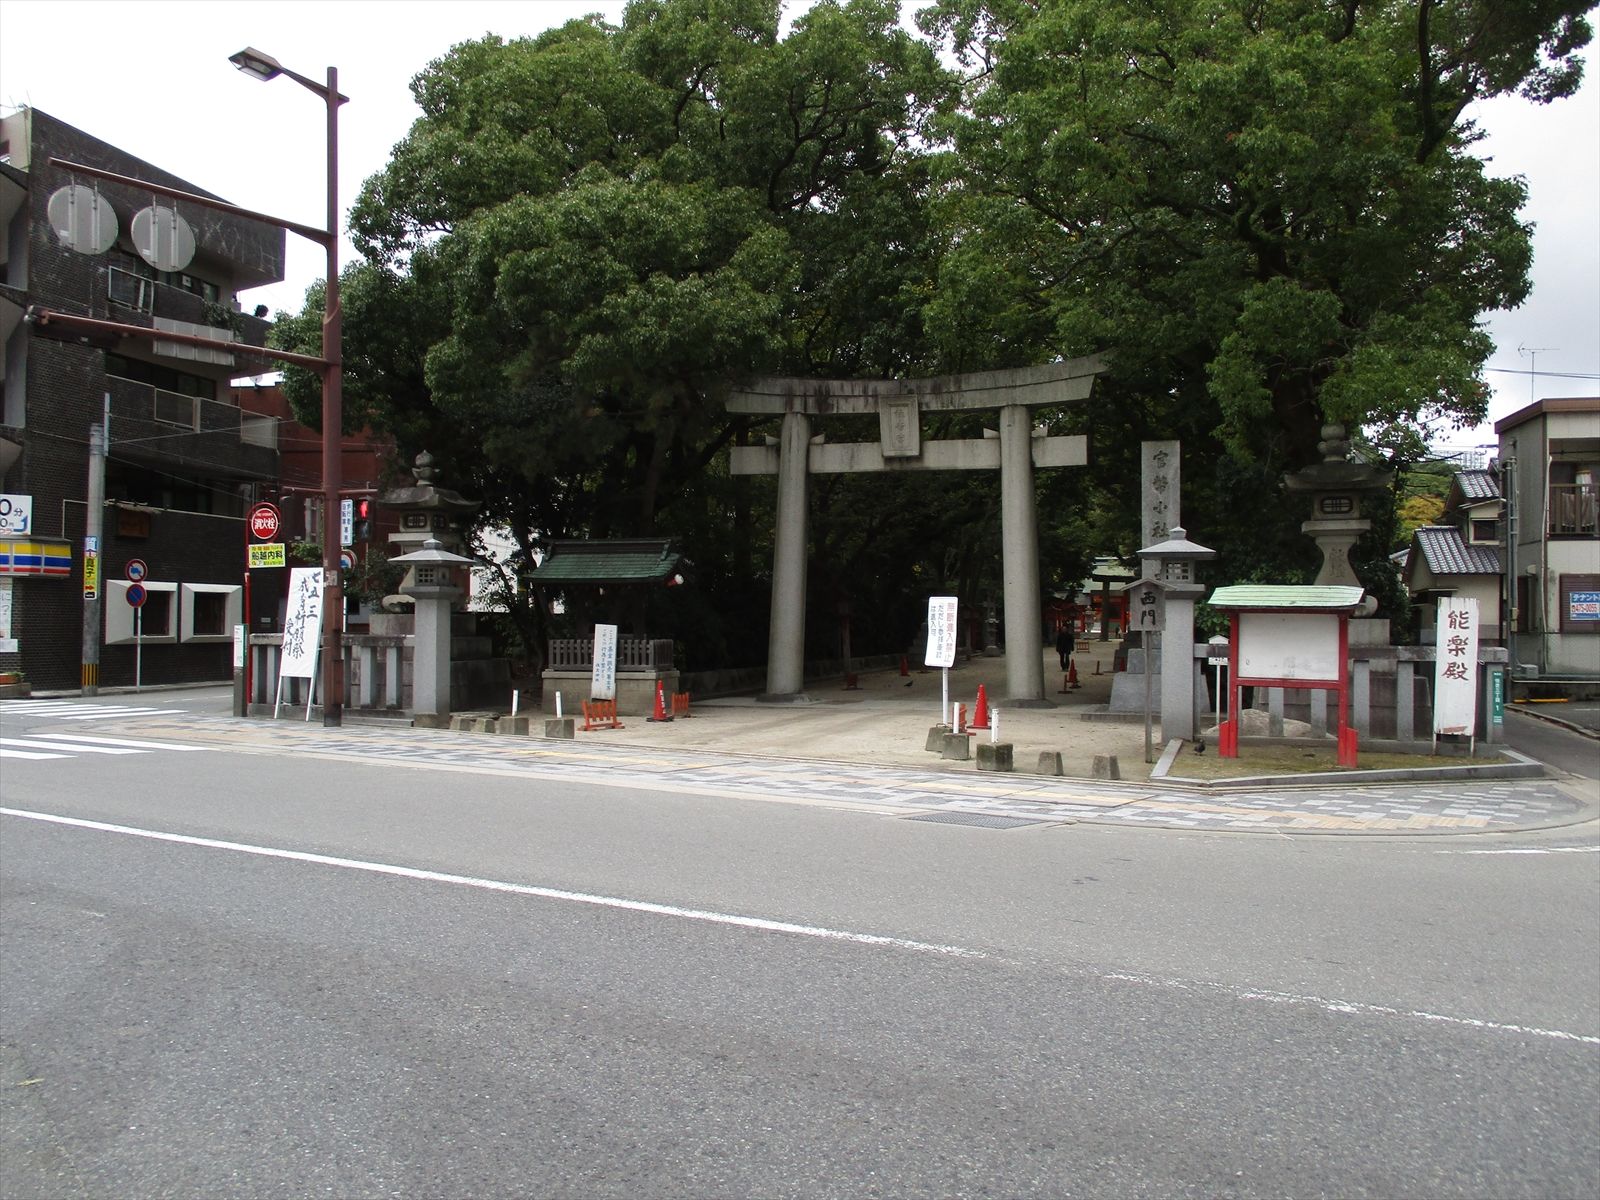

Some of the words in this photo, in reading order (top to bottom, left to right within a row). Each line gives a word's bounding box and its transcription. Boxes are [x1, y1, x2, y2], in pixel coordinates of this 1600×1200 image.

[254, 518, 275, 530] 消火栓
[251, 550, 283, 560] 船越内科
[306, 571, 321, 618] 七五三
[1140, 591, 1156, 626] 西門
[283, 618, 294, 656] 受付
[944, 602, 956, 662] 無断進入禁止
[1441, 610, 1470, 681] 能楽殿
